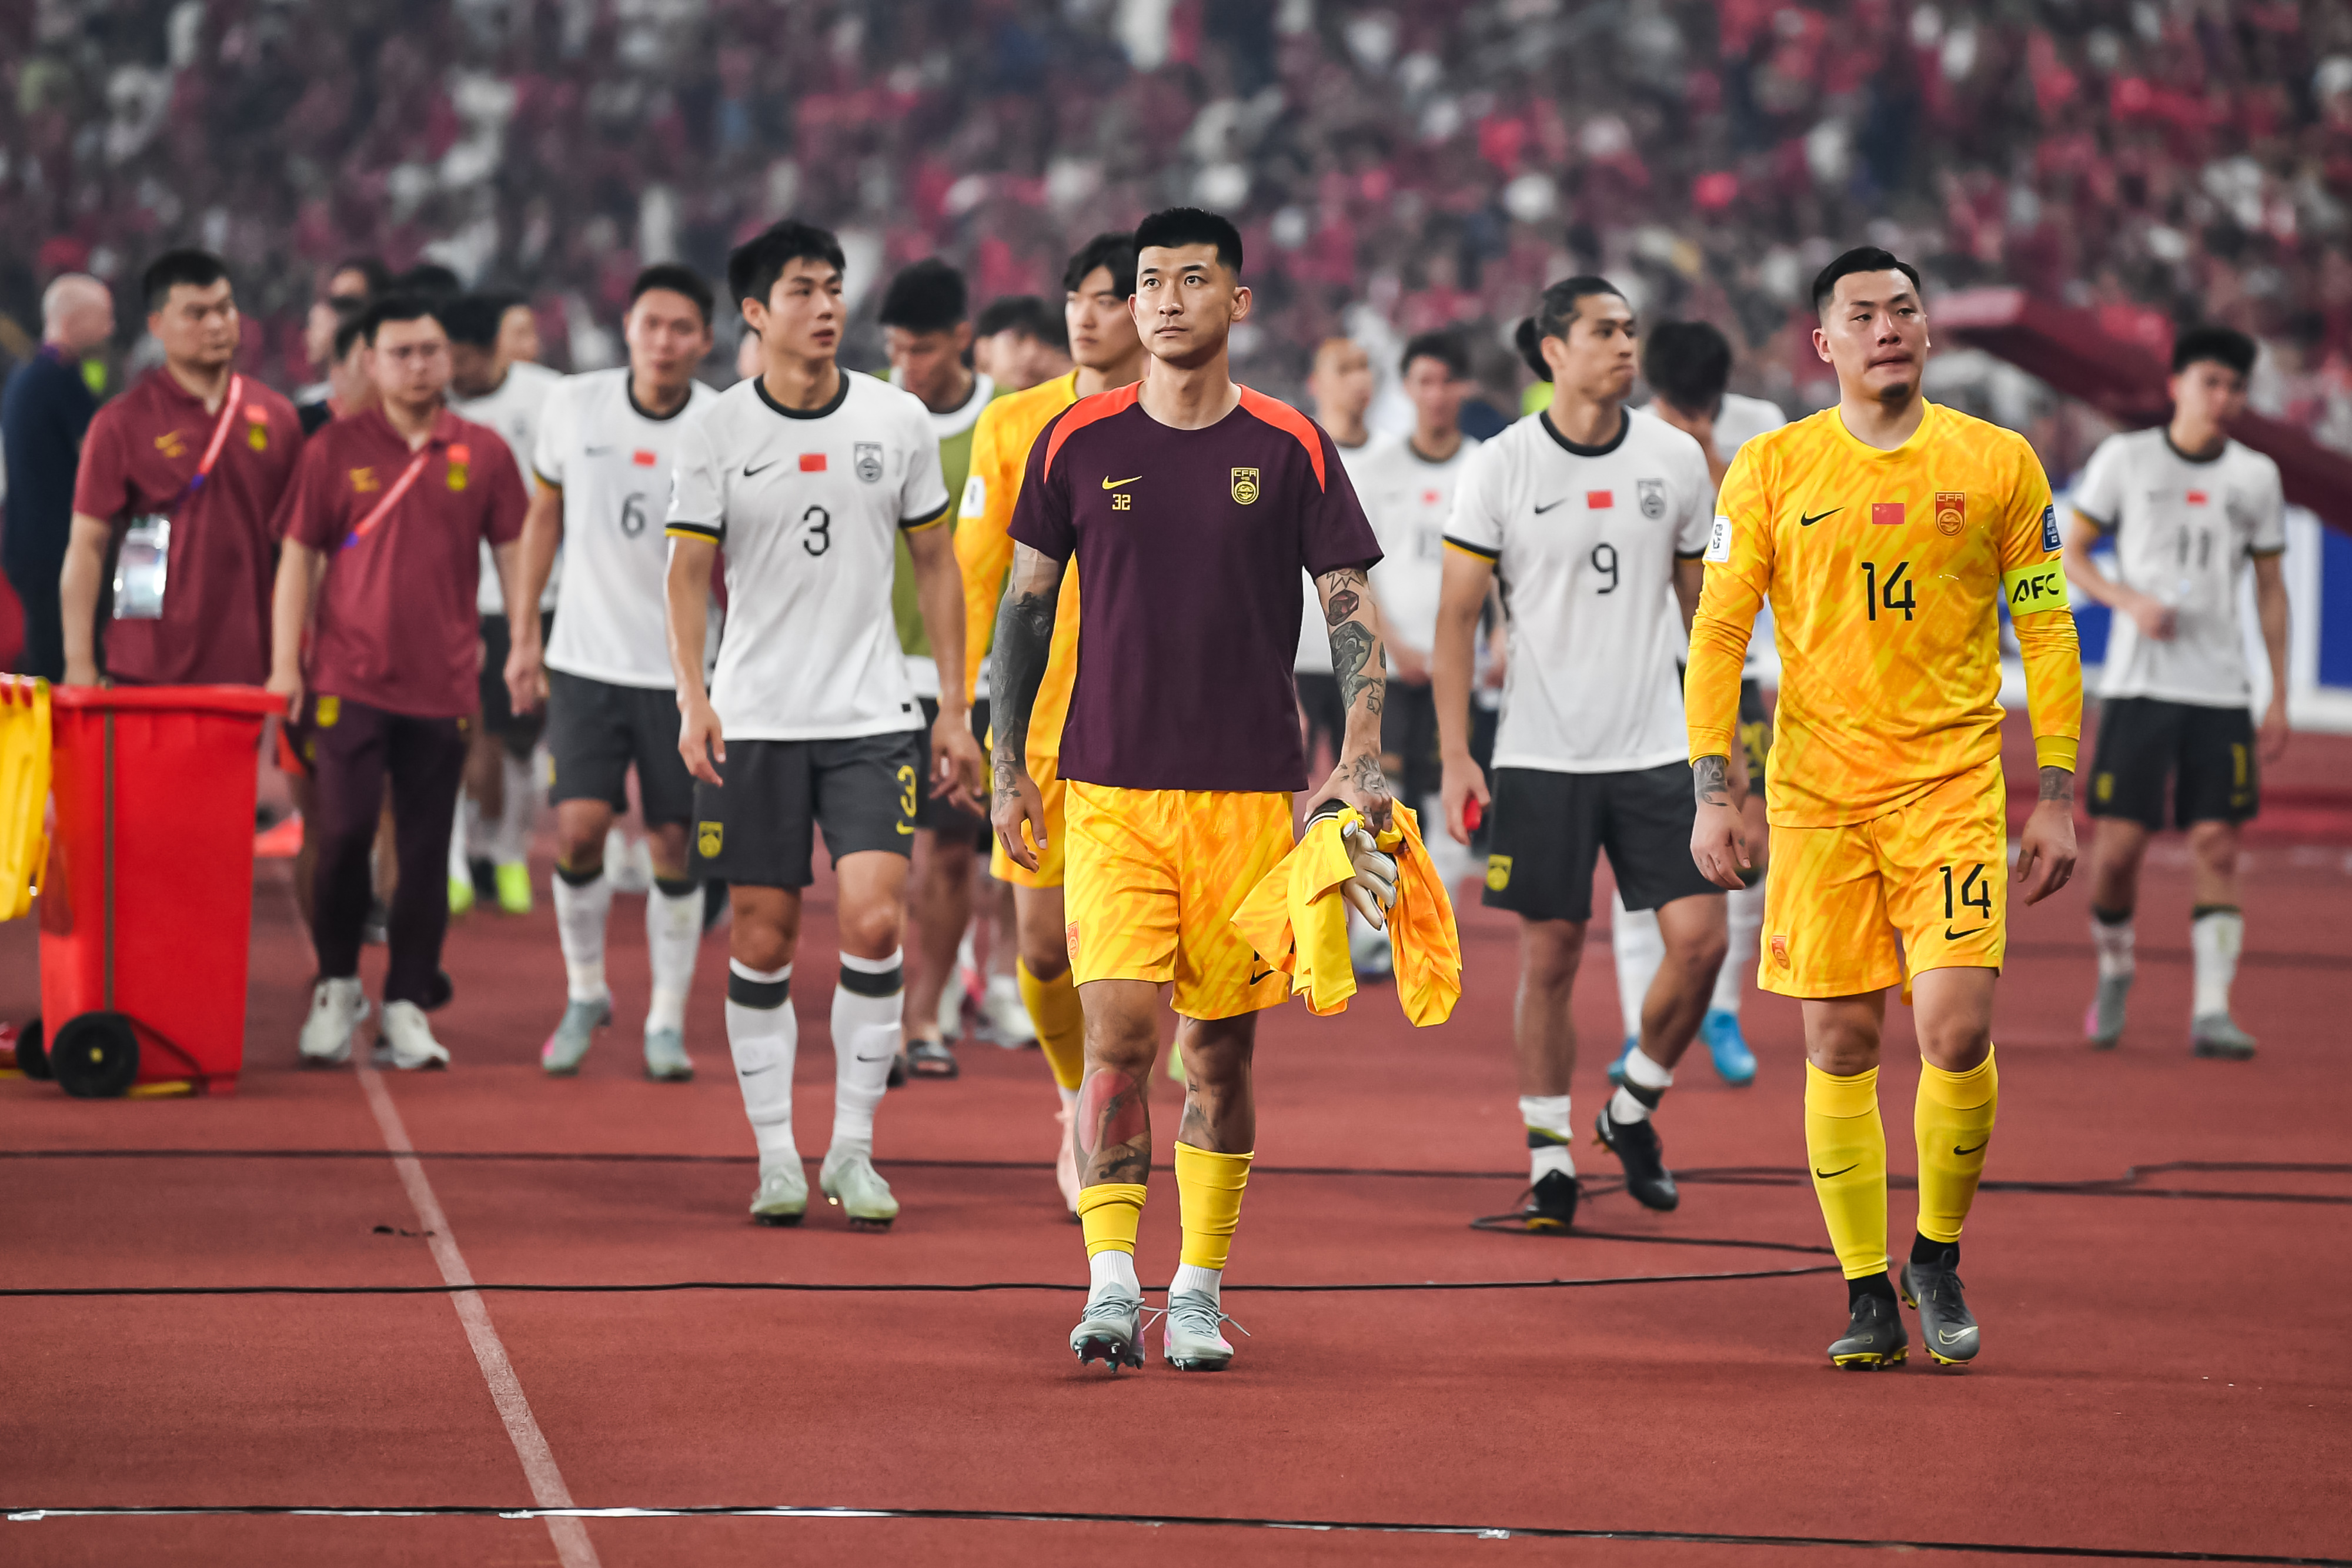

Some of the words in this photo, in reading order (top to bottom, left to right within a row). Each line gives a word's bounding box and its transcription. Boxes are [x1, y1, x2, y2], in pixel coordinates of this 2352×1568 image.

[621, 492, 646, 539] 6
[1112, 494, 1131, 510] 32
[1936, 493, 1963, 502] CFA
[803, 505, 830, 556] 3
[1591, 543, 1618, 594] 9
[1861, 561, 1916, 621] 14
[2012, 573, 2059, 604] AFC
[897, 765, 917, 817] 3
[1939, 863, 1992, 919] 14
